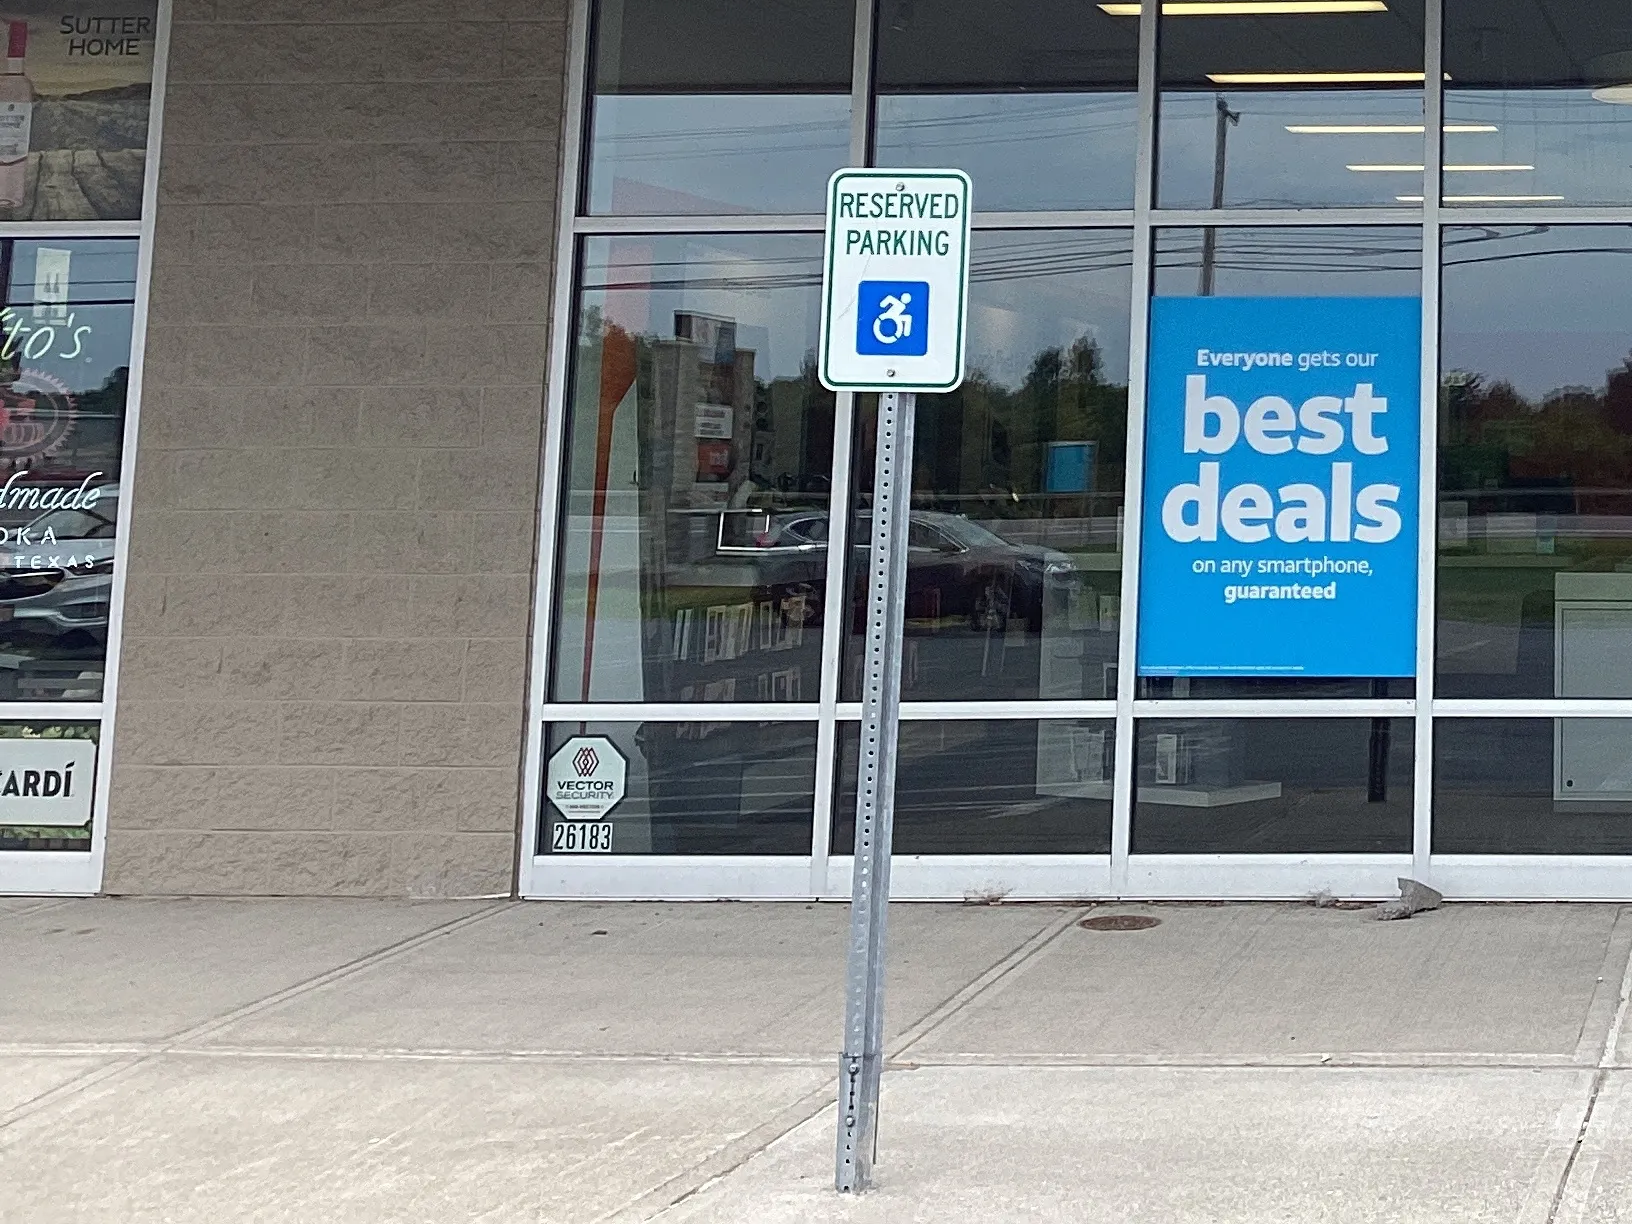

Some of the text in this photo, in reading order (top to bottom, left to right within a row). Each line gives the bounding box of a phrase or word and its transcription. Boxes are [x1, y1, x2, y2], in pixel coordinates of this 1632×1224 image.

[59, 15, 150, 35] SUTTER
[68, 38, 140, 56] HOME
[839, 192, 959, 219] RESERVED
[845, 229, 950, 256] PARKING
[1196, 348, 1379, 371] Everyone gets our
[1183, 374, 1389, 455] best
[1161, 461, 1402, 544] deals
[14, 554, 95, 569] TEXAS
[1192, 556, 1374, 579] on any smartphone,
[1224, 582, 1337, 604] guaranteed
[0, 760, 75, 798] ARDÍ
[557, 780, 614, 790] VECTOR
[556, 791, 614, 800] SECURITY
[553, 823, 612, 850] 26183
